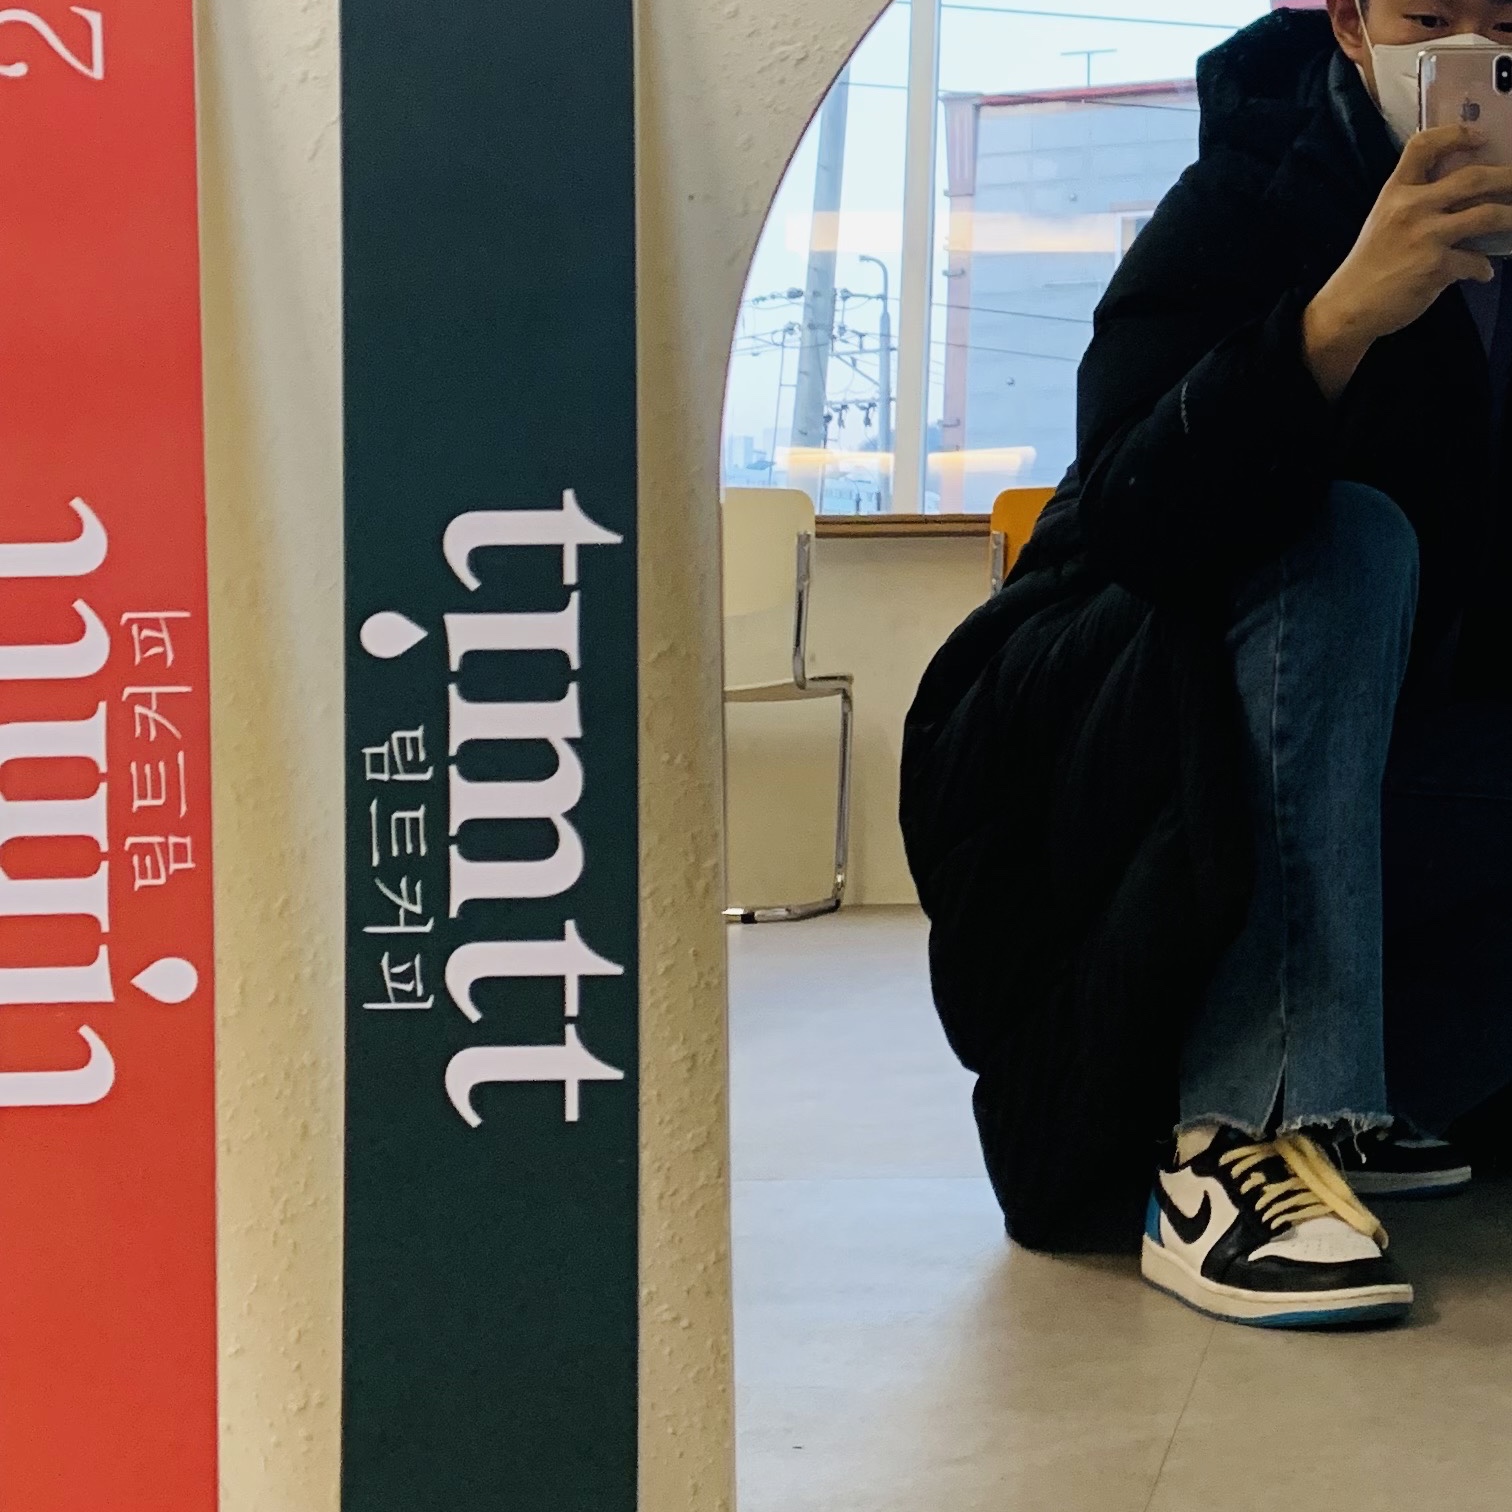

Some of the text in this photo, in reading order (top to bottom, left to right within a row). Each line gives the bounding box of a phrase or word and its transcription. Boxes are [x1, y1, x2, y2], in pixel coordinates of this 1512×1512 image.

[120, 611, 196, 891] 팀트커피
[361, 725, 435, 1010] 팀트커피
[442, 488, 625, 1128] timtt
